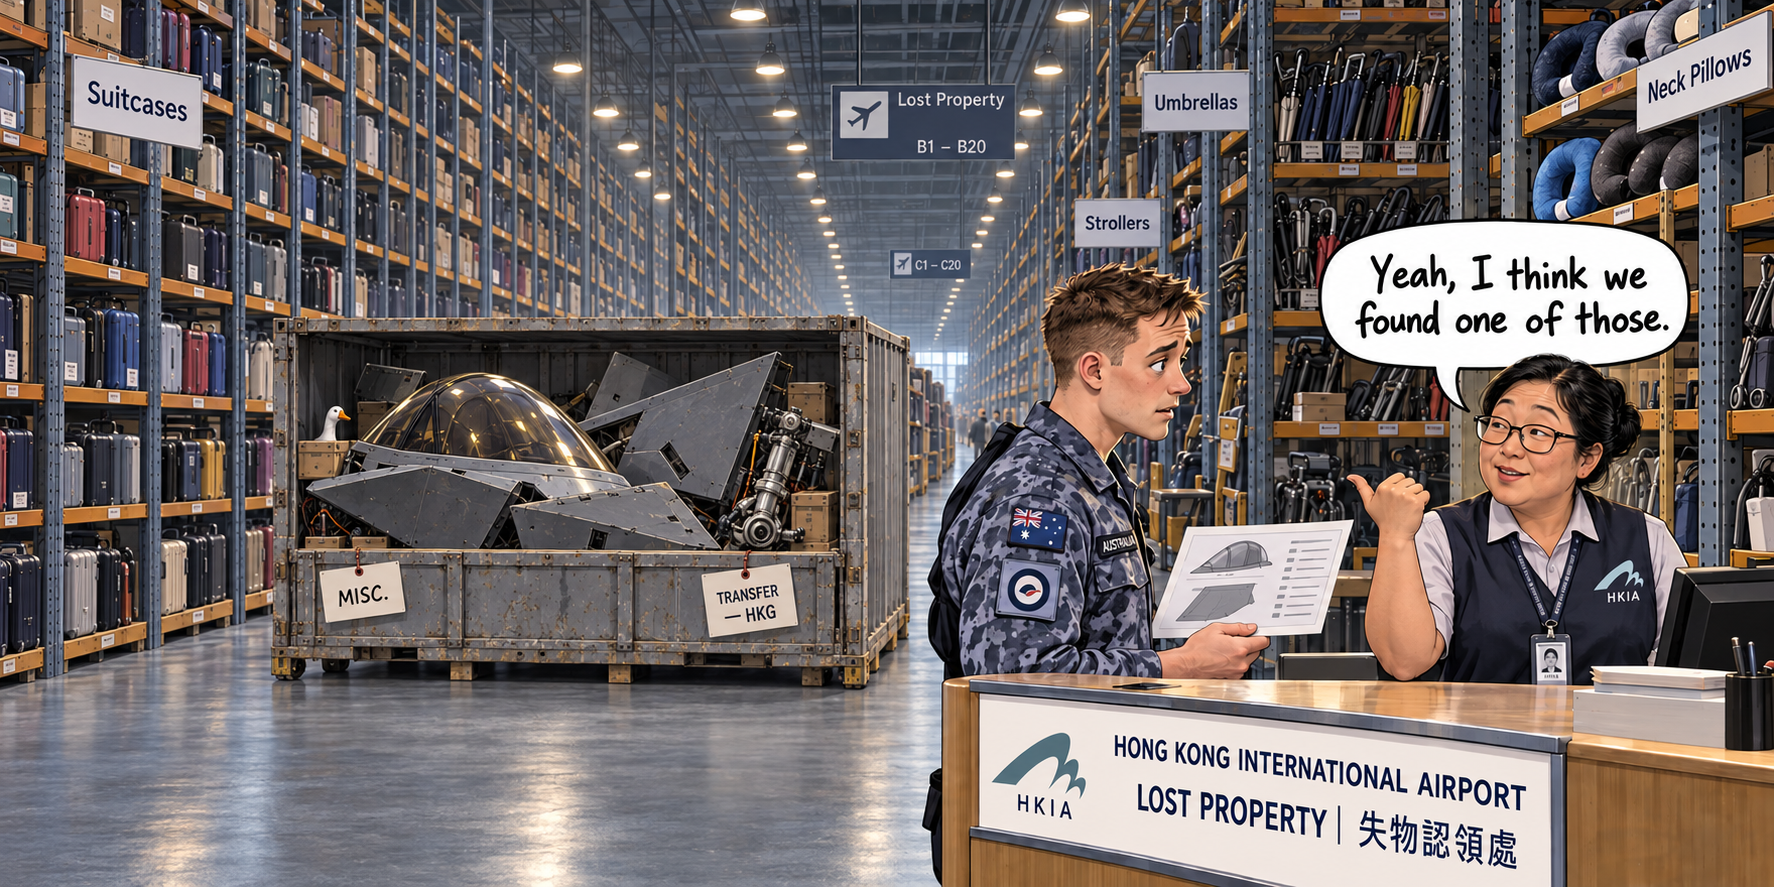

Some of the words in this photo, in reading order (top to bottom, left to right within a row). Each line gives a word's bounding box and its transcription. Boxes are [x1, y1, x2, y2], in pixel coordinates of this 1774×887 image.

[1648, 69, 1687, 104] Neck
[1690, 48, 1753, 88] Pillows
[87, 80, 188, 122] Suitcases
[898, 92, 931, 107] Lost
[936, 92, 1005, 110] Property
[1154, 92, 1238, 112] Umbrellas
[917, 139, 933, 154] B1
[957, 139, 986, 154] B20
[1085, 214, 1151, 231] Strollers
[914, 259, 928, 271] C1
[940, 259, 962, 271] C20
[1370, 253, 1456, 295] Yeah,
[1471, 254, 1494, 291] I
[1506, 255, 1588, 291] think
[1604, 267, 1648, 291] we
[1354, 299, 1441, 339] found
[1455, 312, 1508, 334] one
[1525, 299, 1564, 337] of
[1574, 300, 1669, 335] those.
[338, 584, 389, 608] MISC.
[716, 584, 779, 605] TRANSFER
[1607, 590, 1640, 603] HKIA
[745, 604, 777, 623] HKG
[1114, 734, 1168, 762] HONG
[1175, 741, 1230, 769] KONG
[1238, 748, 1408, 794] INTERNATIONAL
[1417, 771, 1527, 811] AIRPORT
[1017, 793, 1073, 820] HKIA
[1137, 783, 1192, 817] LOST
[1200, 791, 1328, 839] PROPERTY
[1359, 810, 1517, 870] 失物認領處
